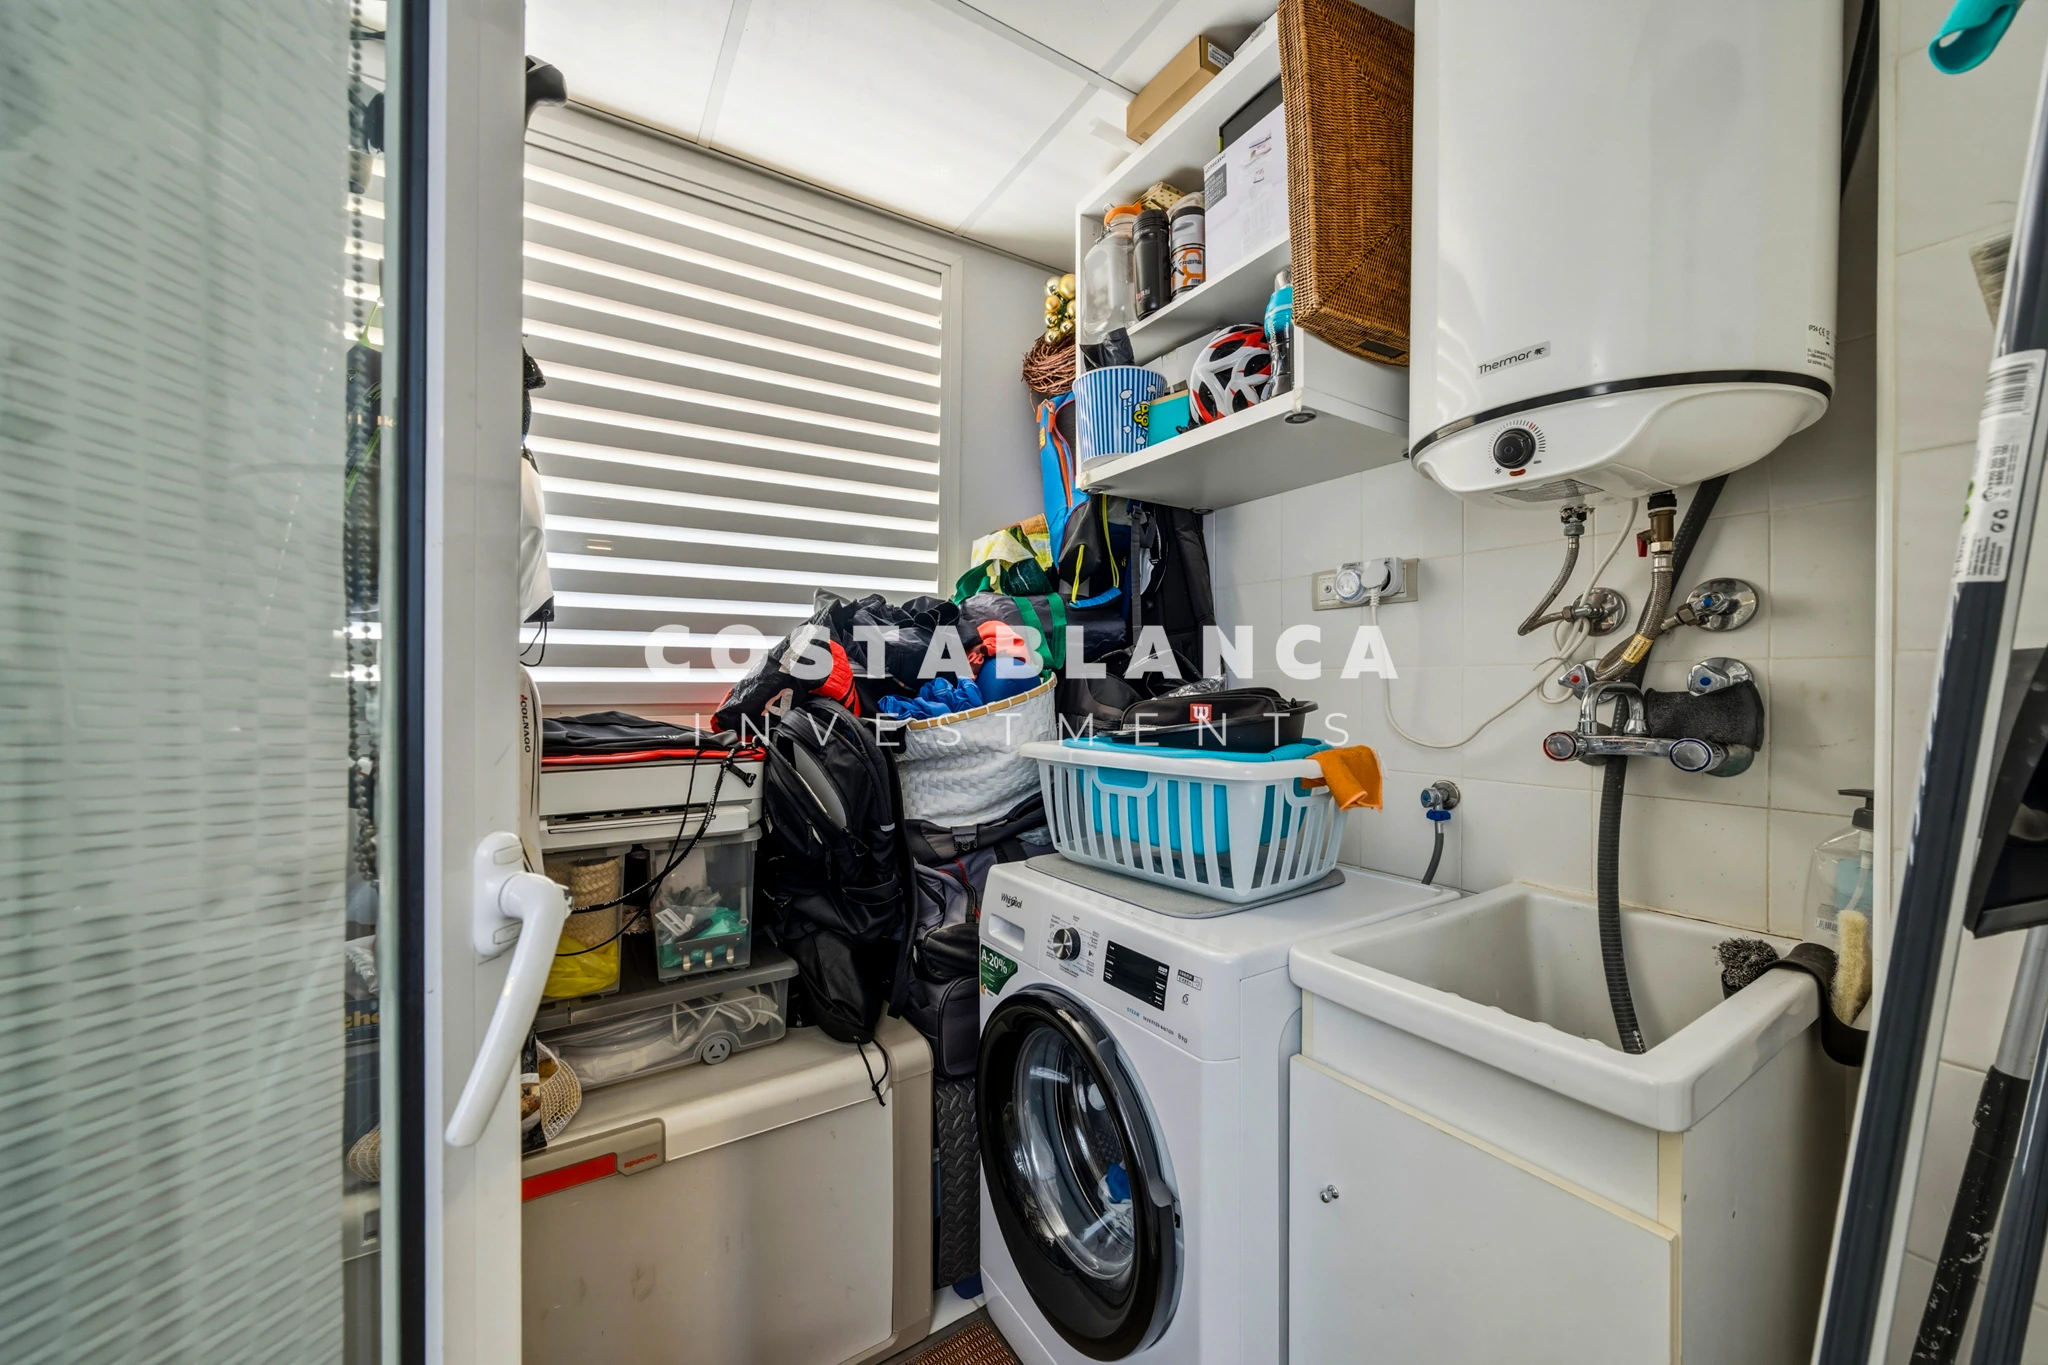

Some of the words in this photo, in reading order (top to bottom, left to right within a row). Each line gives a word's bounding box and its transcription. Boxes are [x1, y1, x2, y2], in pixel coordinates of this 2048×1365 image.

[1478, 350, 1532, 375] Thermor
[520, 700, 531, 753] COLNAGO
[1000, 892, 1023, 909] Whirlpool
[981, 948, 1008, 974] A-20%
